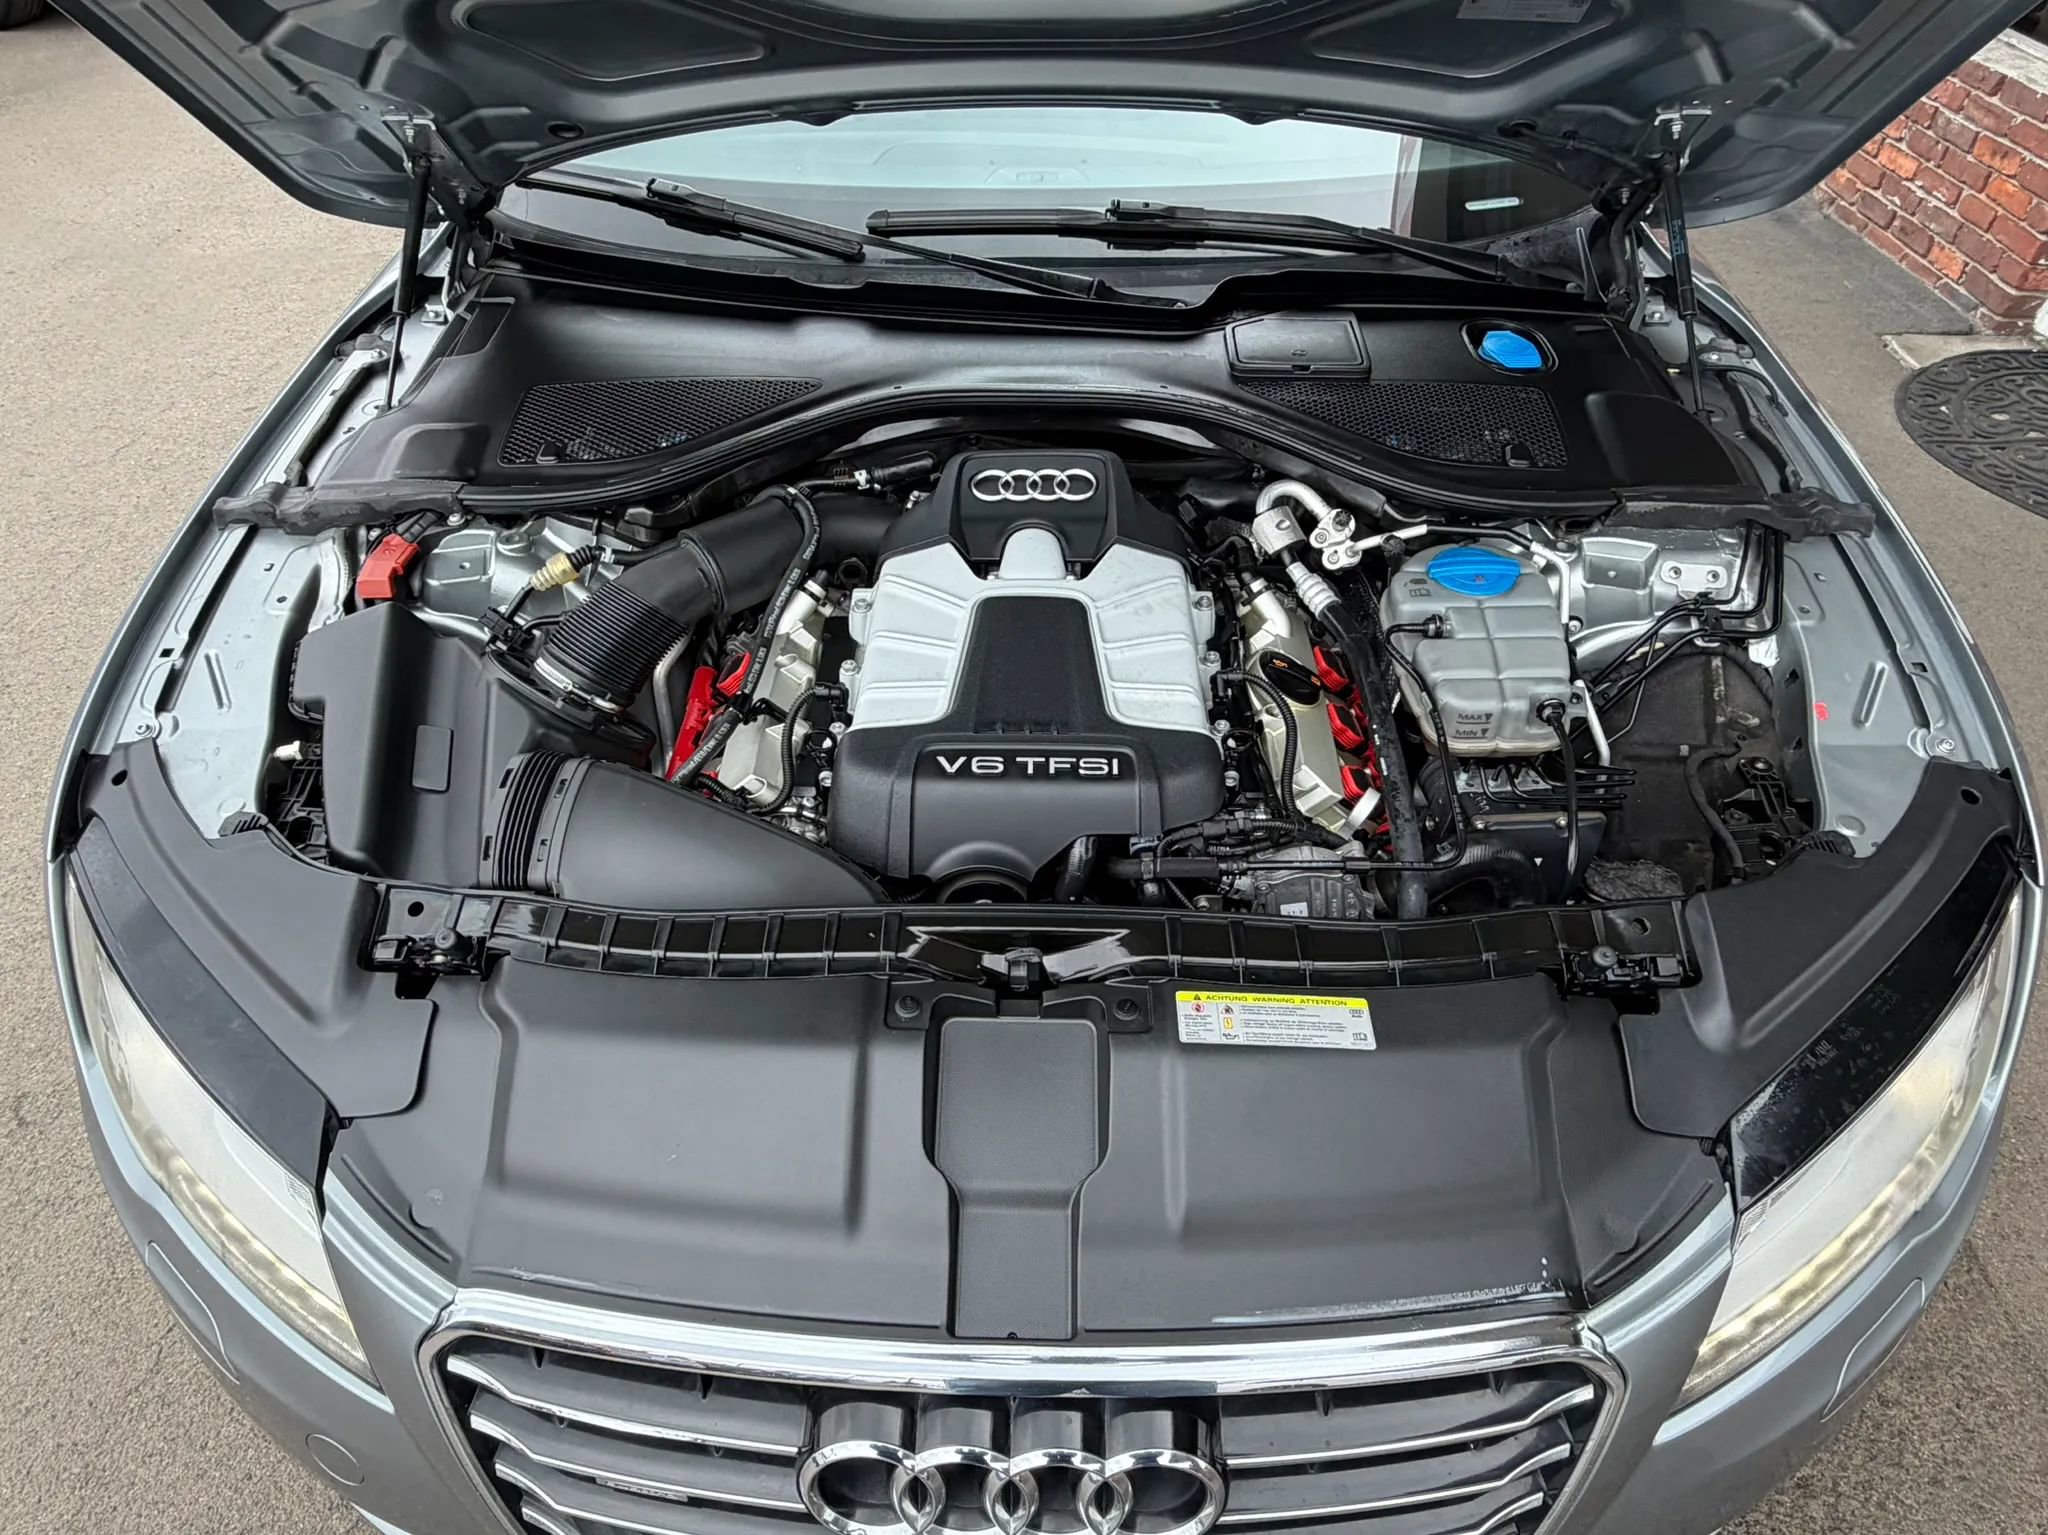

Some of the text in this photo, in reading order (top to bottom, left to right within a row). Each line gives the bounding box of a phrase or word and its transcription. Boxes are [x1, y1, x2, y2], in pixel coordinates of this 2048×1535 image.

[1457, 713, 1483, 721] MAX
[1455, 728, 1479, 737] MIN
[936, 756, 1119, 775] V6 TFSI
[1205, 994, 1348, 1007] ACHTUNG WARNING ATTENTION
